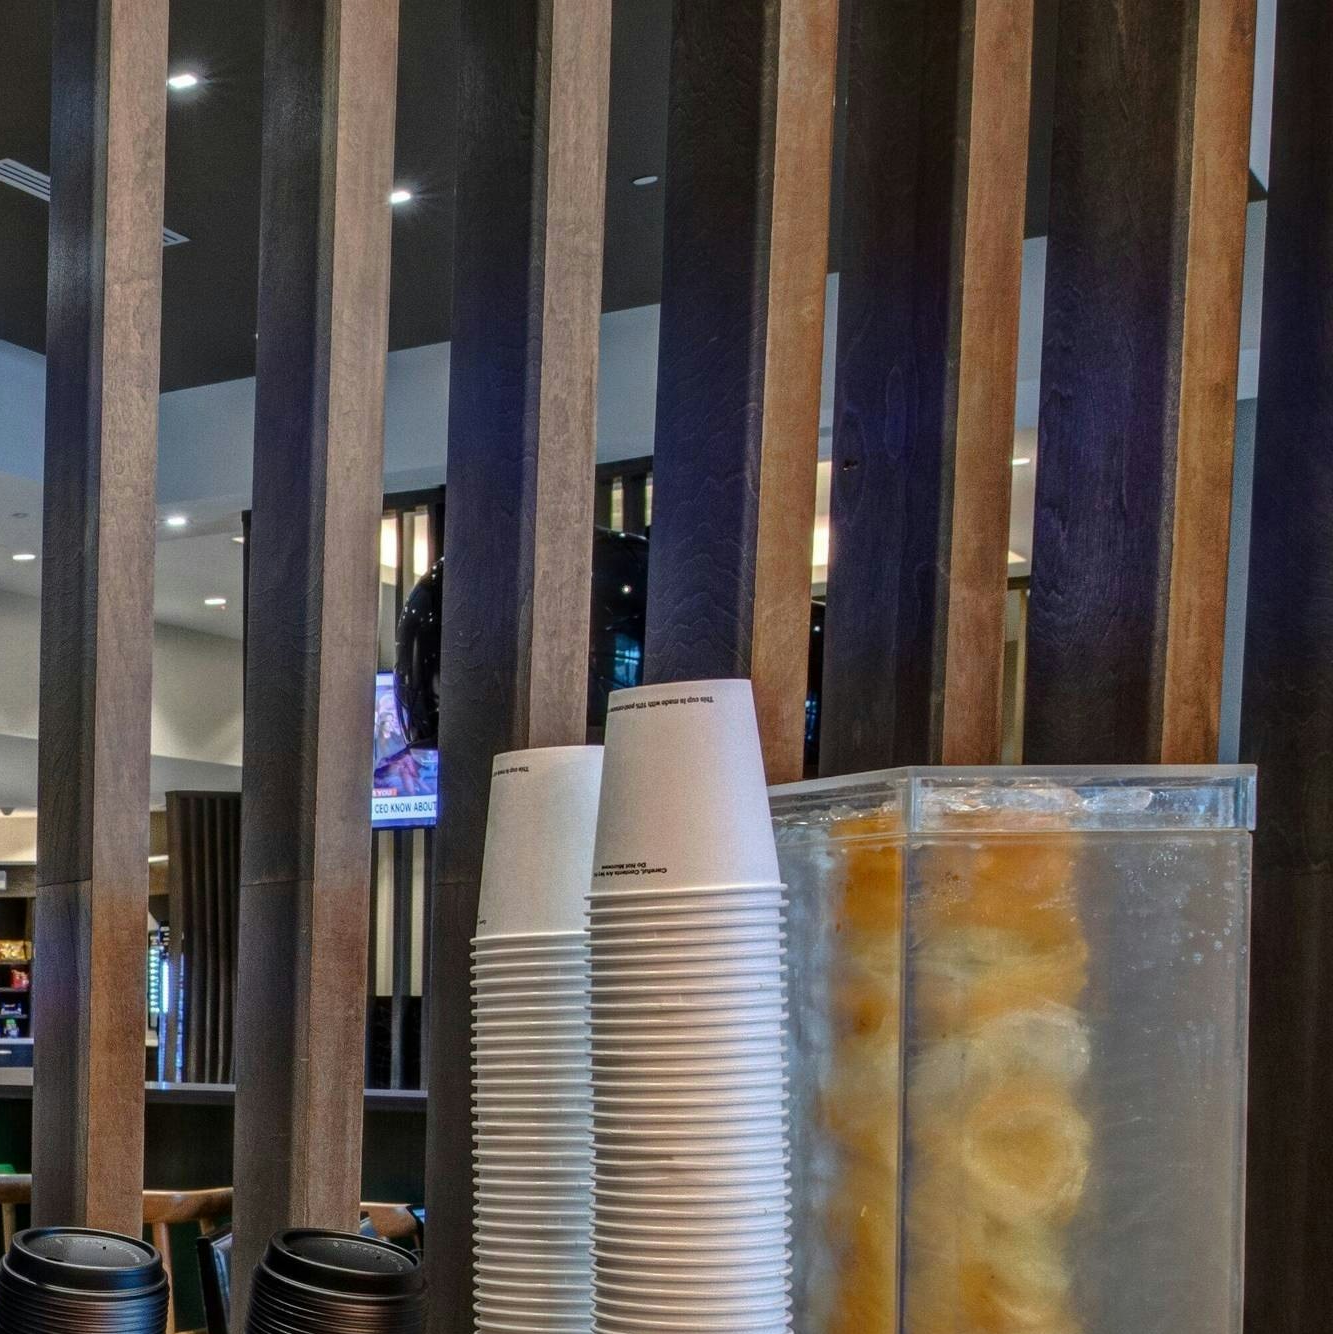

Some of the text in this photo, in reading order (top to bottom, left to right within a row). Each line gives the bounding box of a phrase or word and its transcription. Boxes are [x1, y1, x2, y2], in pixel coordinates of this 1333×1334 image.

[375, 802, 437, 814] CEO KNOW ABOUT
